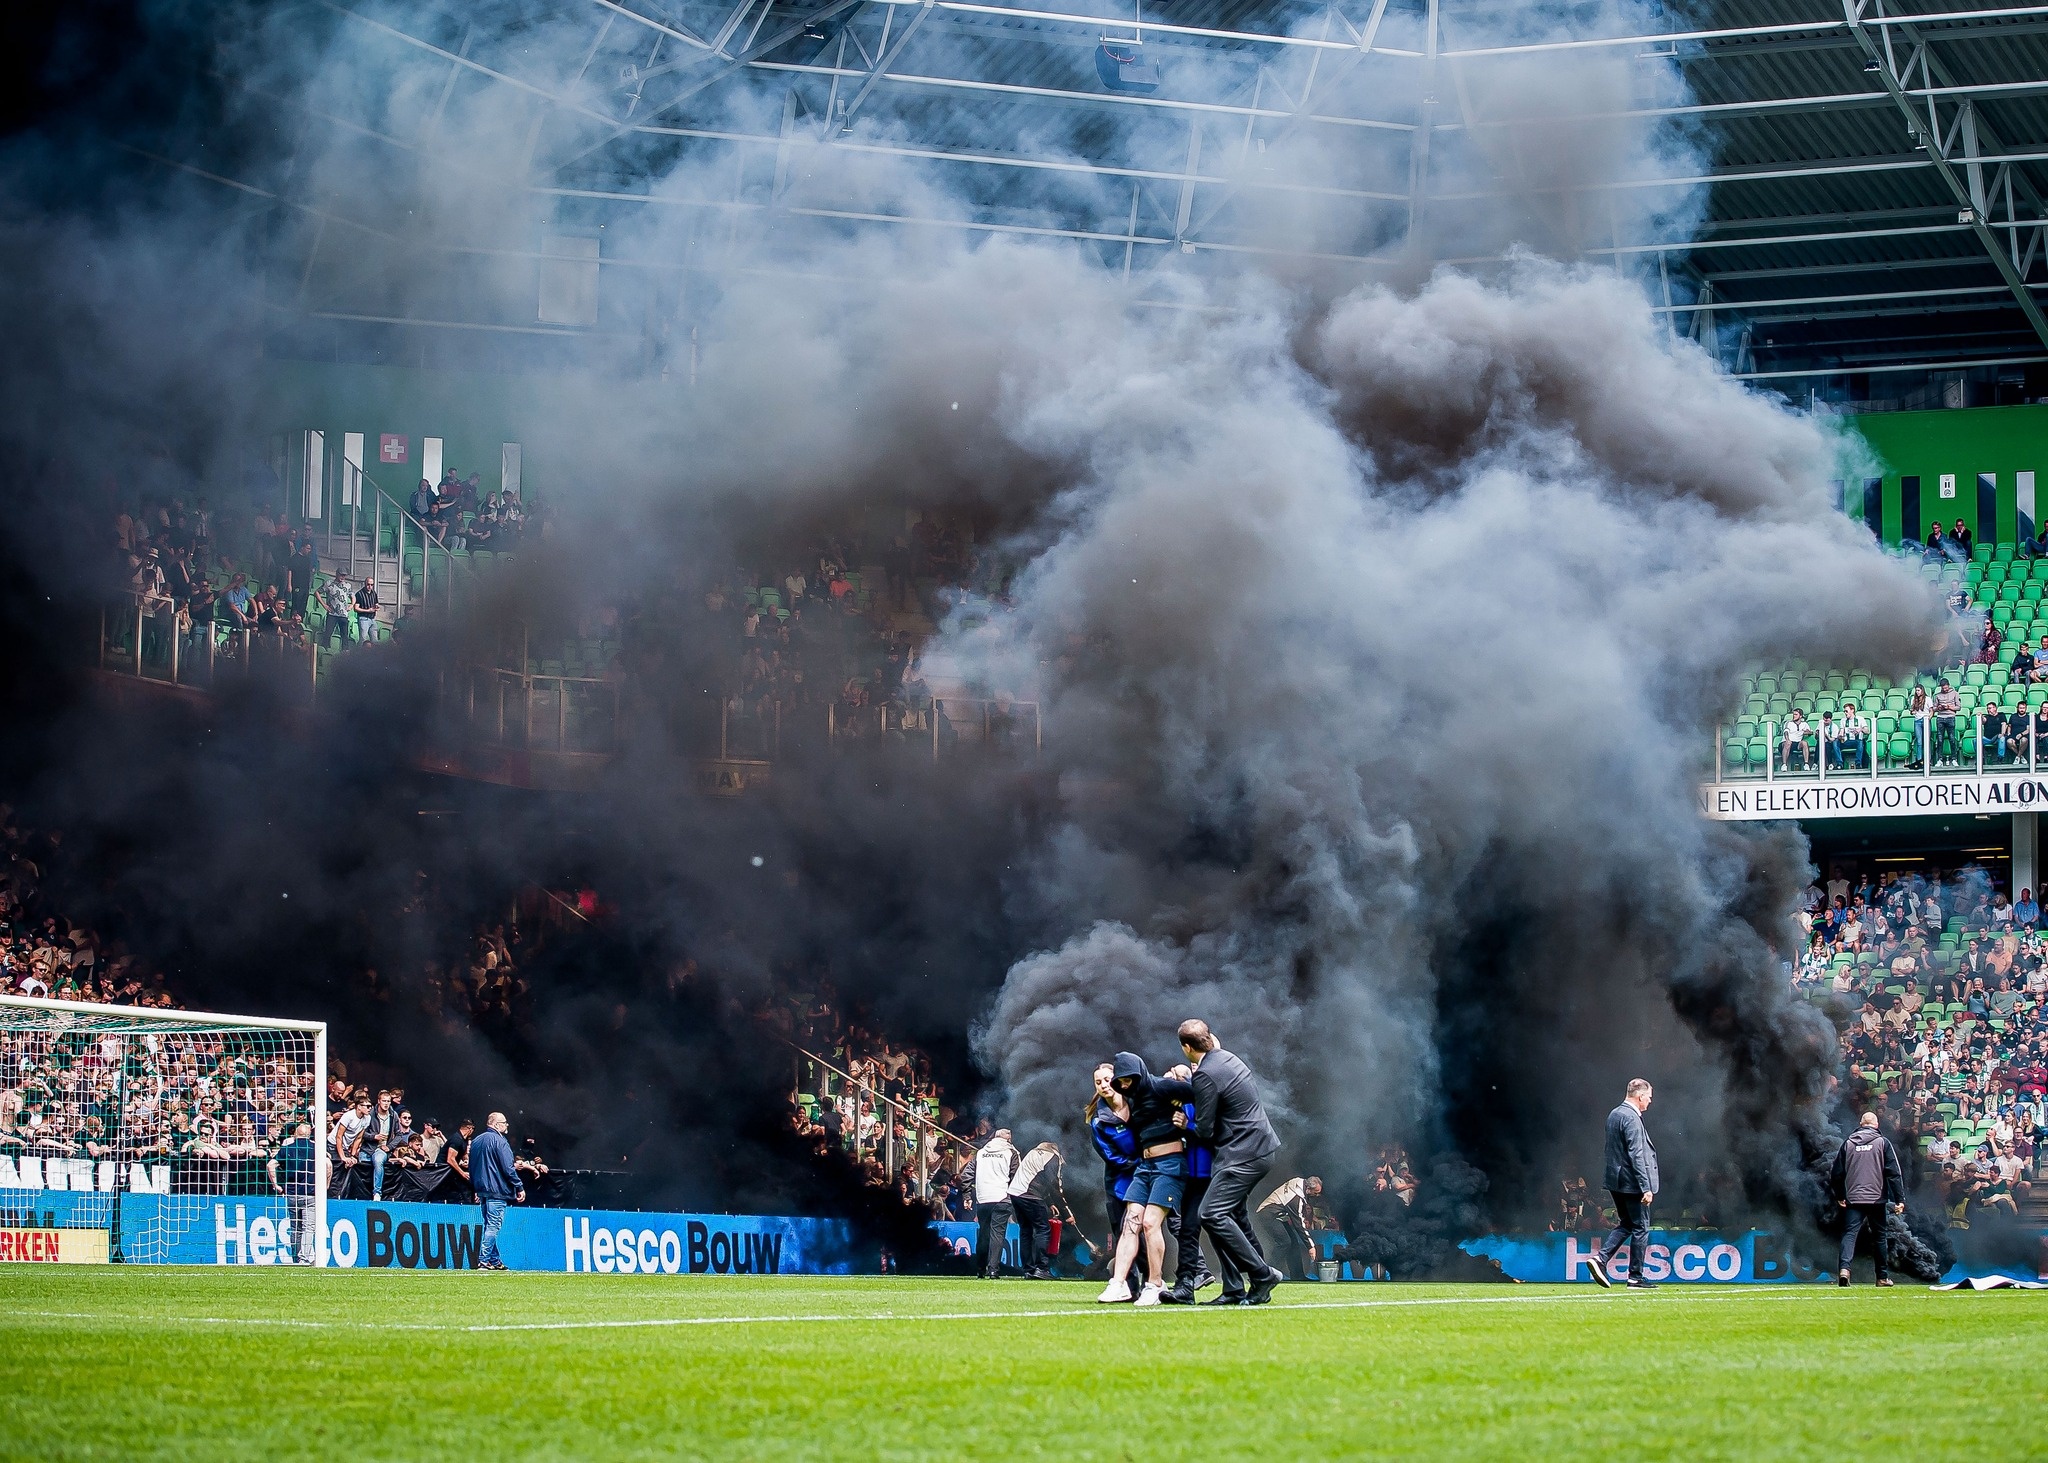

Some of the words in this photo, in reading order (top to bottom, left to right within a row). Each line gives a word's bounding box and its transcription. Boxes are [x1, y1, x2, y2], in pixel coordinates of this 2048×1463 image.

[1718, 791, 1747, 813] EN
[1756, 783, 1981, 811] ELEKTROMOTOREN
[1855, 1144, 1874, 1152] STAF
[215, 1203, 359, 1268] Heso
[367, 1208, 483, 1269] Bouw
[564, 1216, 682, 1274] Hesco
[687, 1220, 783, 1274] Bouw
